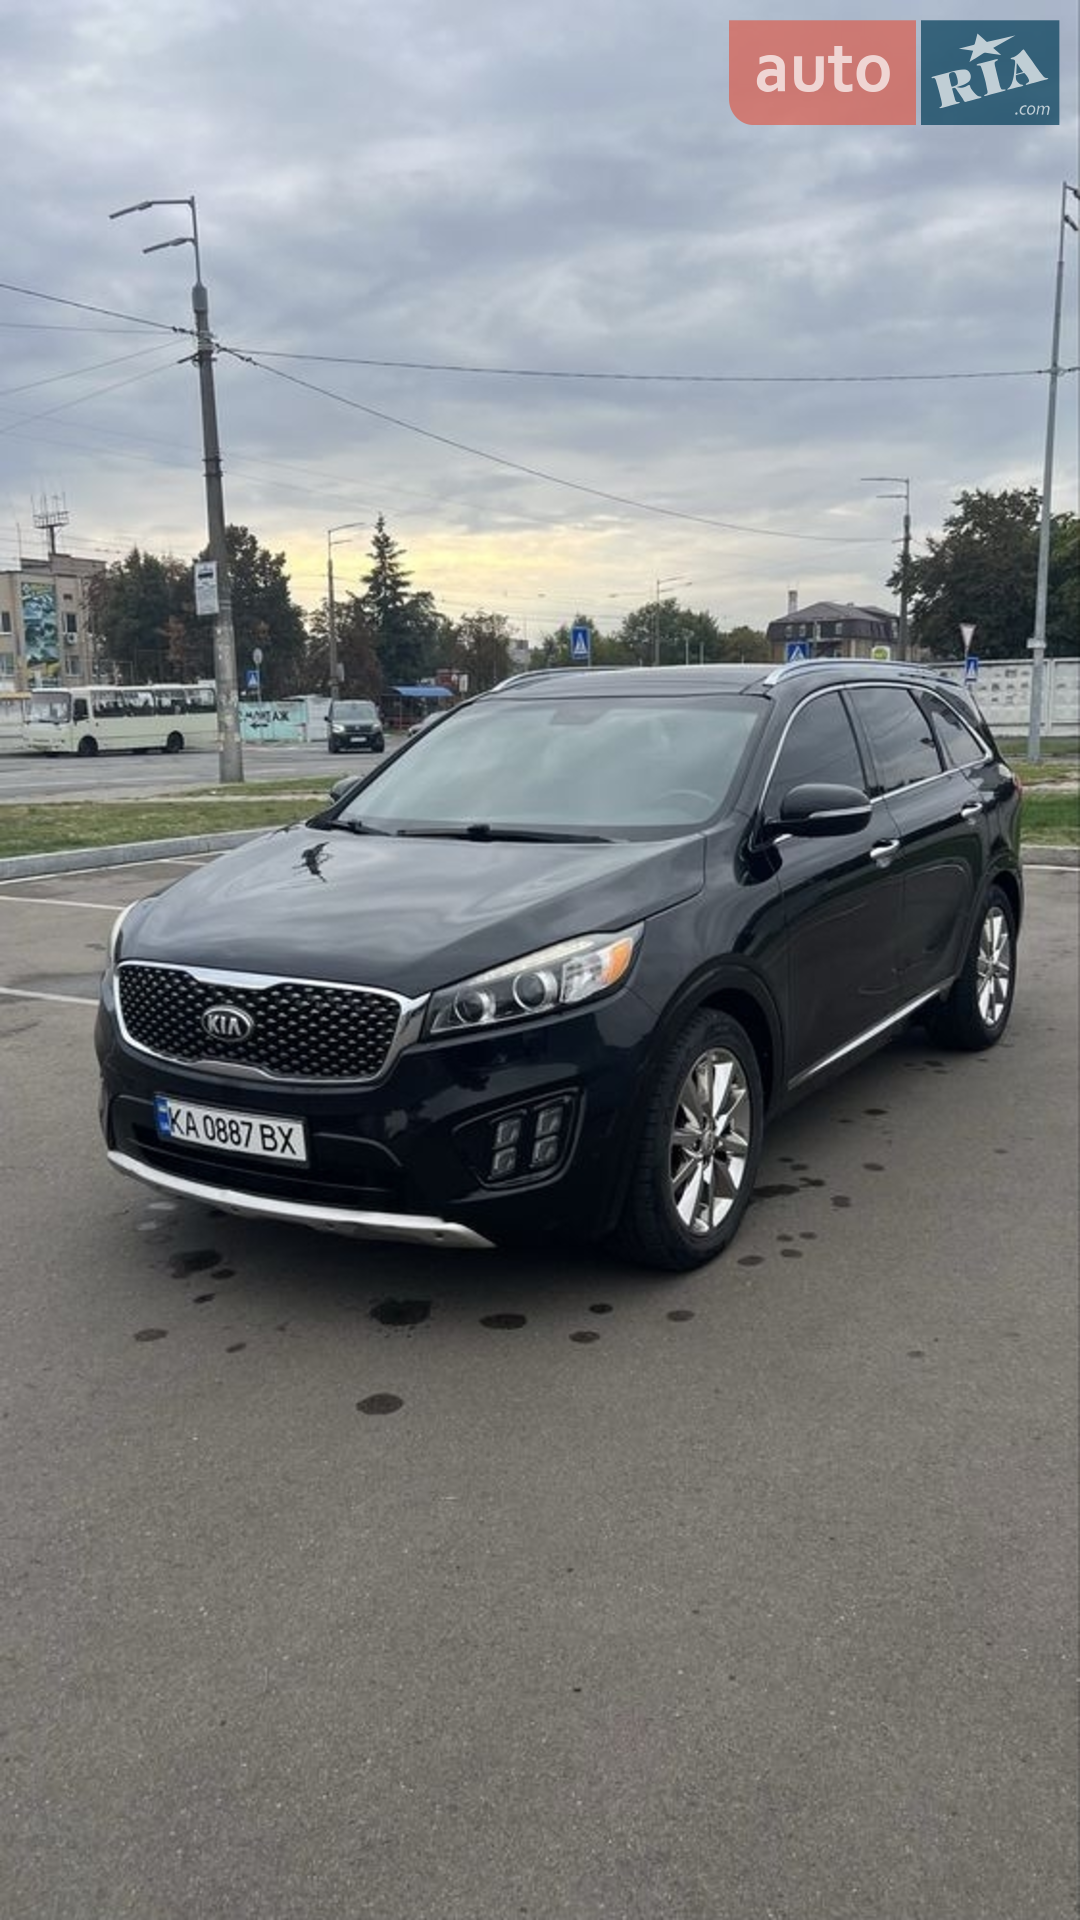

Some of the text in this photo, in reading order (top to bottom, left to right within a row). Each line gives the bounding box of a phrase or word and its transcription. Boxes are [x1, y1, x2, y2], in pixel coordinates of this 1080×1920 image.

[208, 1014, 241, 1036] KIA
[168, 1106, 297, 1155] KA 0887 BX
